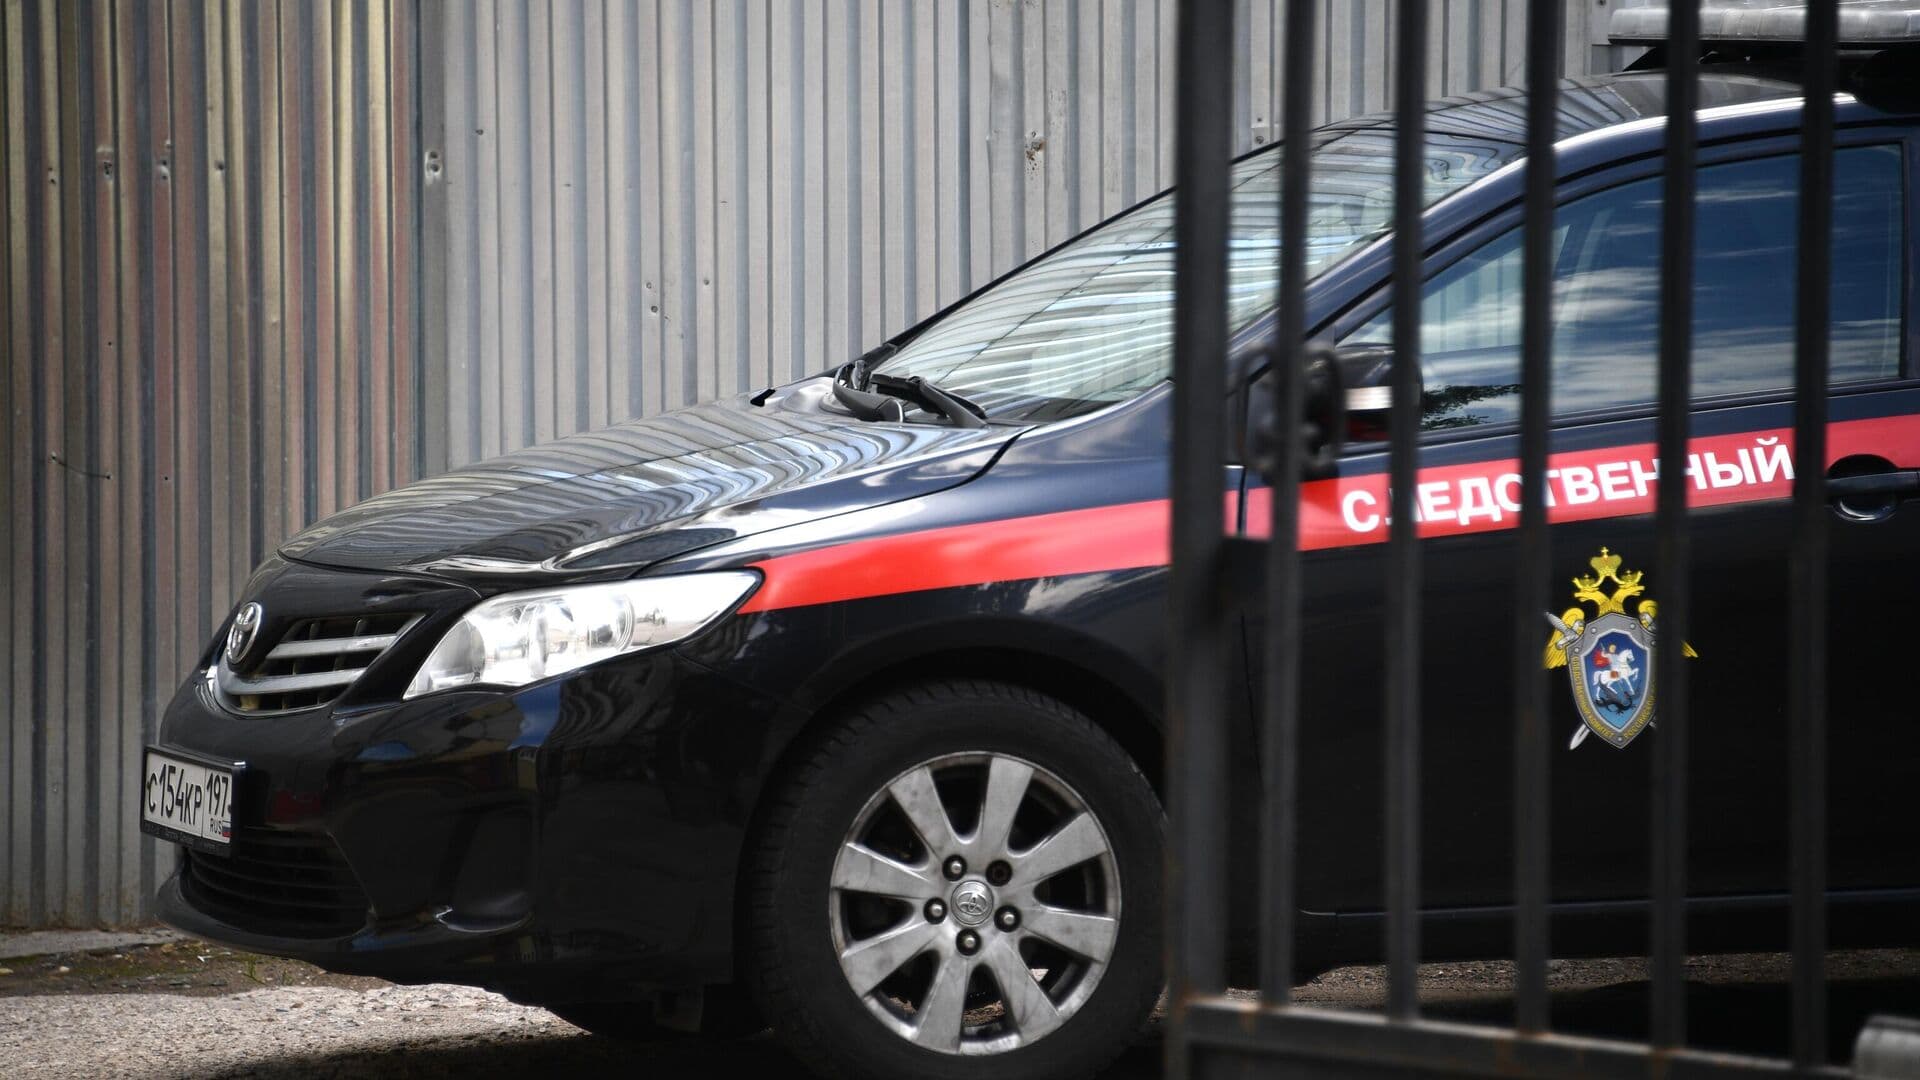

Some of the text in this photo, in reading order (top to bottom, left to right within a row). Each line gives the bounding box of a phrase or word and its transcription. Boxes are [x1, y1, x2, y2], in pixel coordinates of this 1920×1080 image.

[148, 763, 229, 826] С154КР 197
[210, 817, 223, 835] RUS
